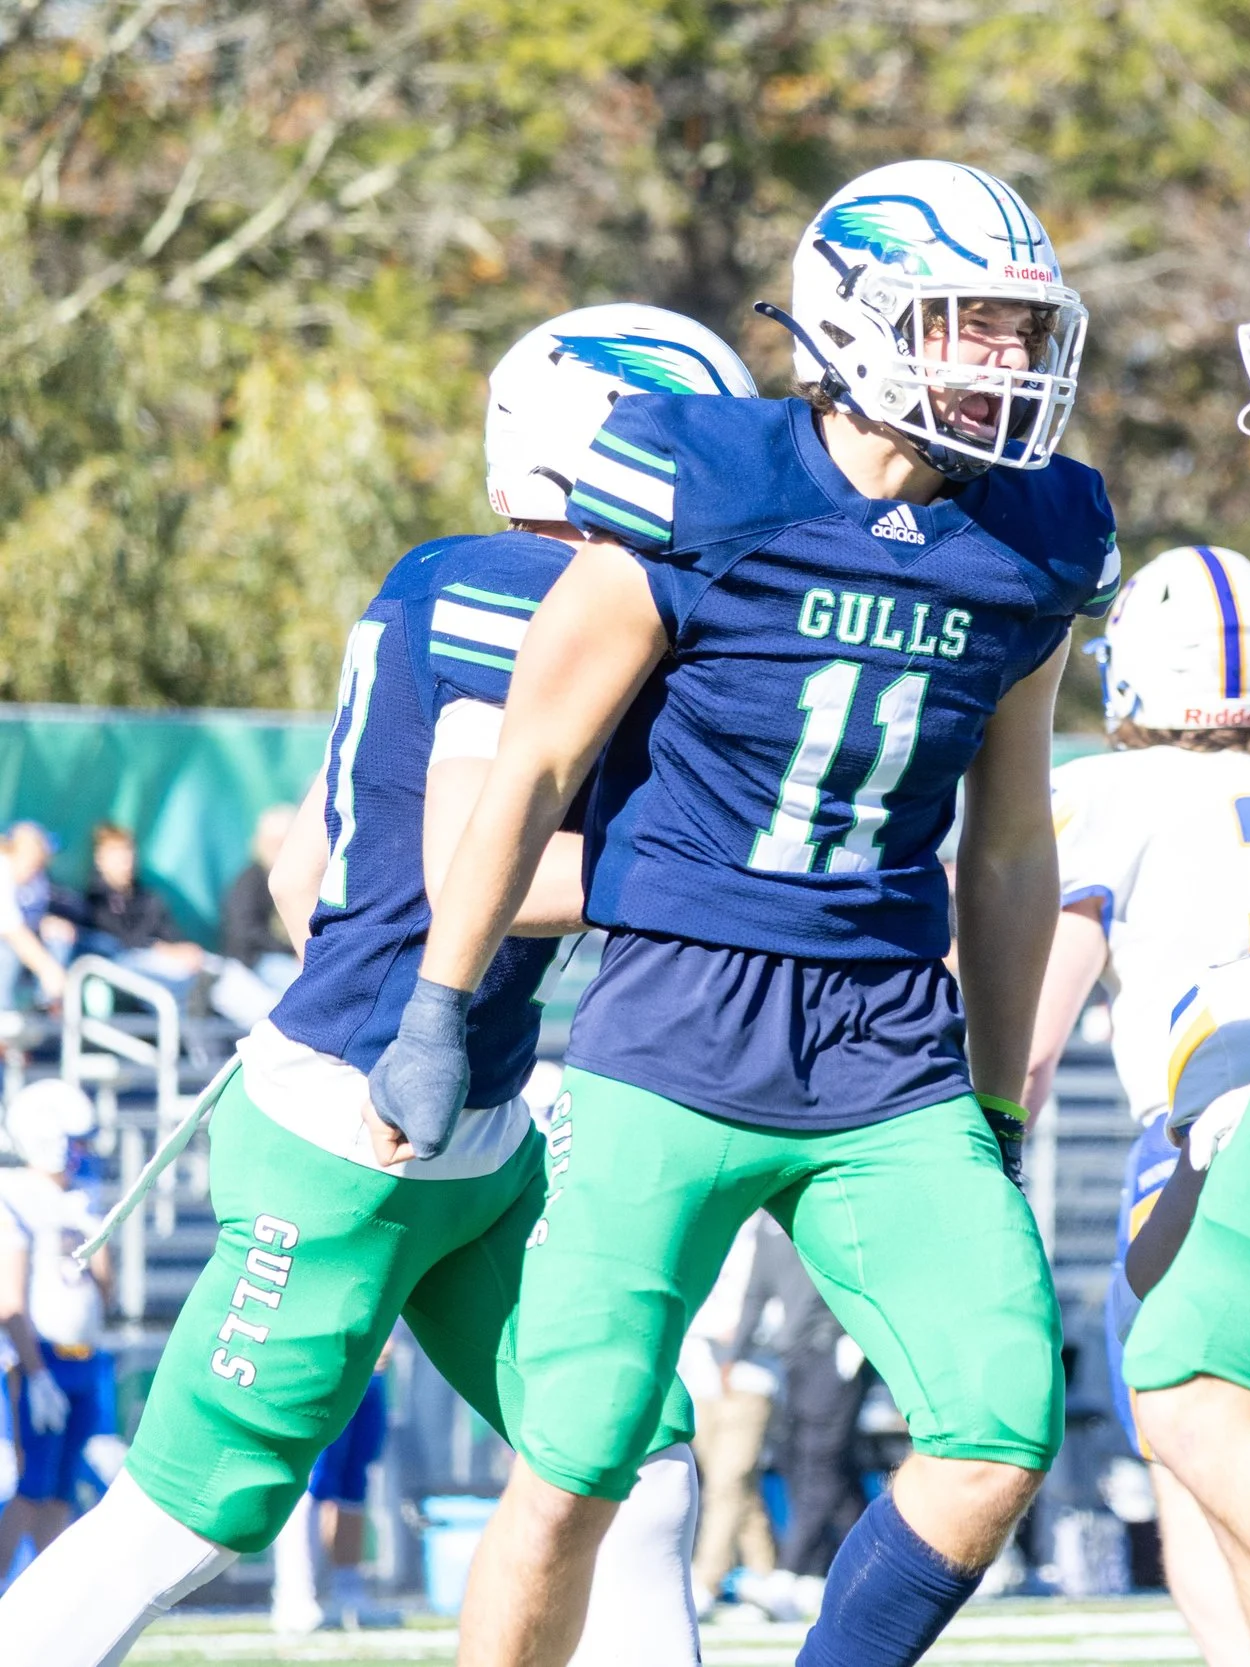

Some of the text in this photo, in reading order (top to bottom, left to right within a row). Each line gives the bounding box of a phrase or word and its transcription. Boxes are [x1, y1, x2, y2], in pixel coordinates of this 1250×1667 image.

[1004, 264, 1053, 283] Riddell
[871, 523, 926, 546] adidas
[797, 587, 973, 660] GULLS
[747, 659, 931, 873] 11
[211, 1213, 300, 1388] GULLS
